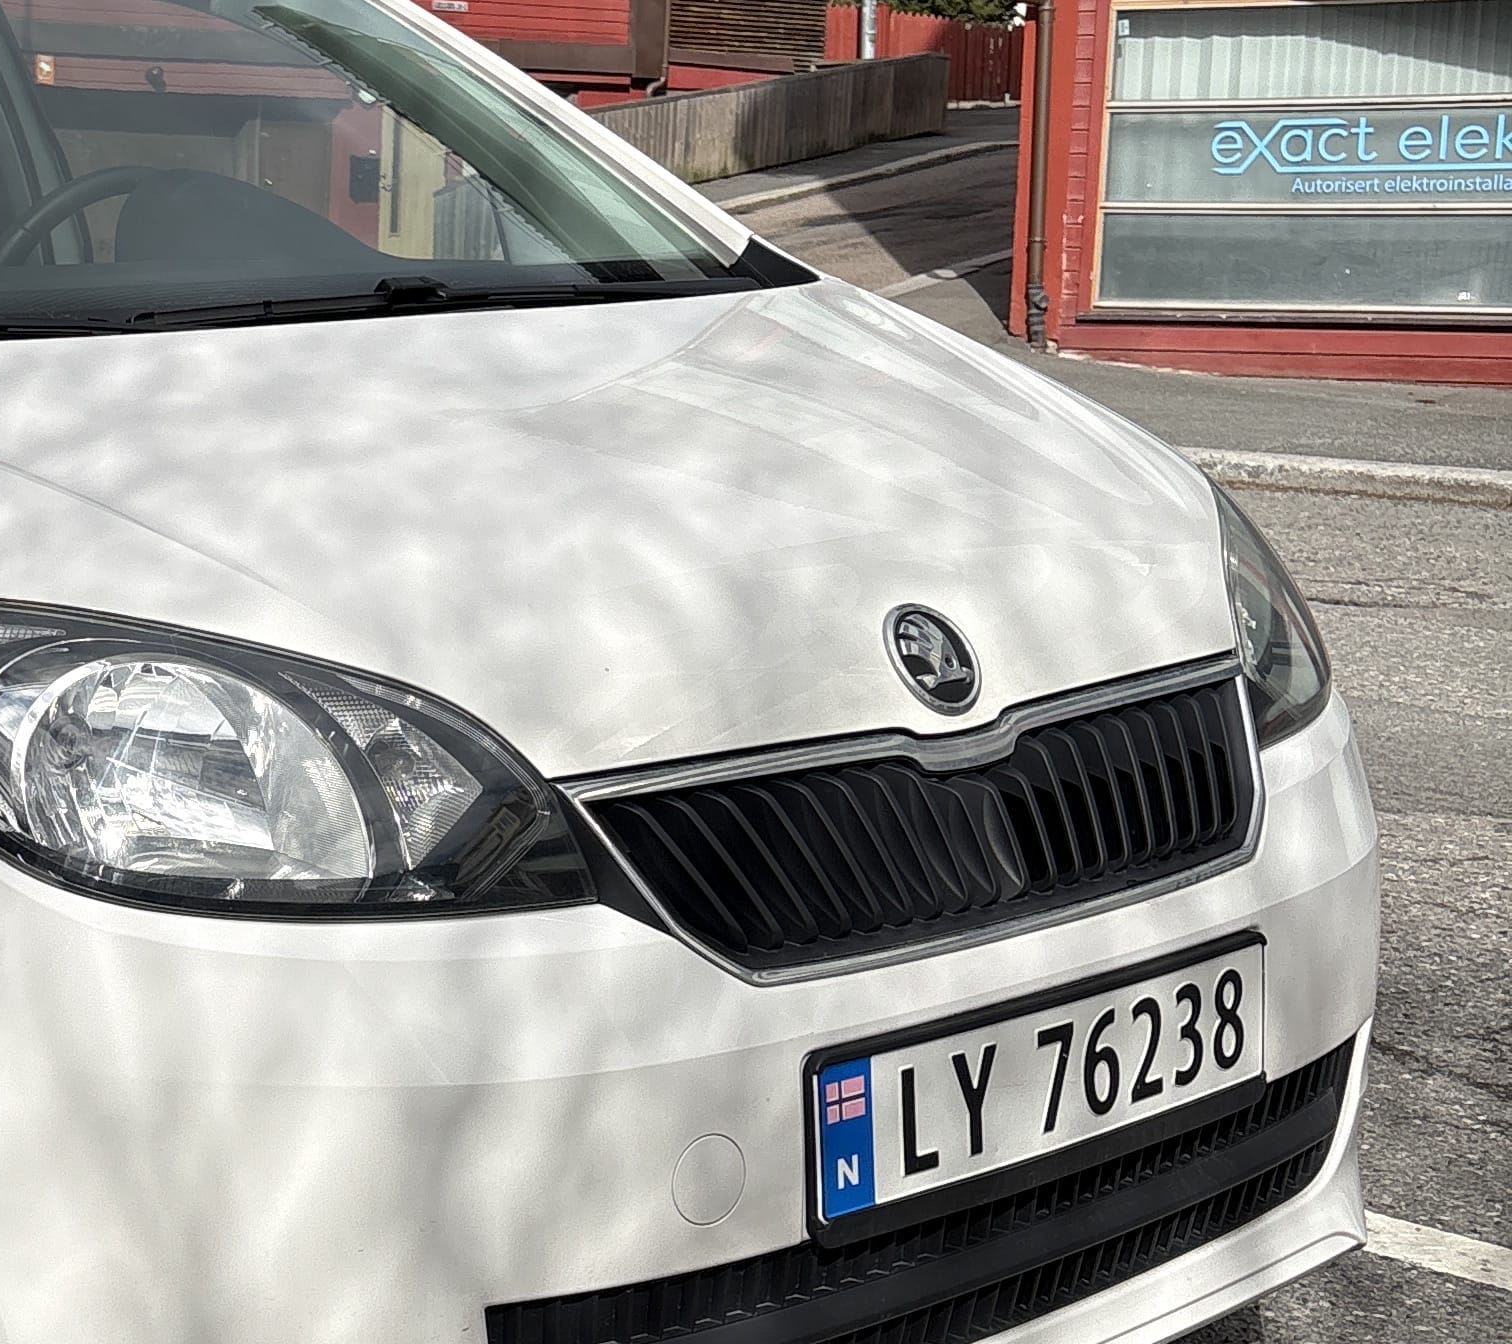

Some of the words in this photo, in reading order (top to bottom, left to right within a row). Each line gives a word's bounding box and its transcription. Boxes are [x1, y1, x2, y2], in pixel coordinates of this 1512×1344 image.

[1211, 116, 1378, 174] exact
[1291, 176, 1381, 194] Autorisert
[898, 1042, 998, 1177] LY
[1036, 967, 1245, 1135] 76238
[836, 1153, 860, 1191] N
